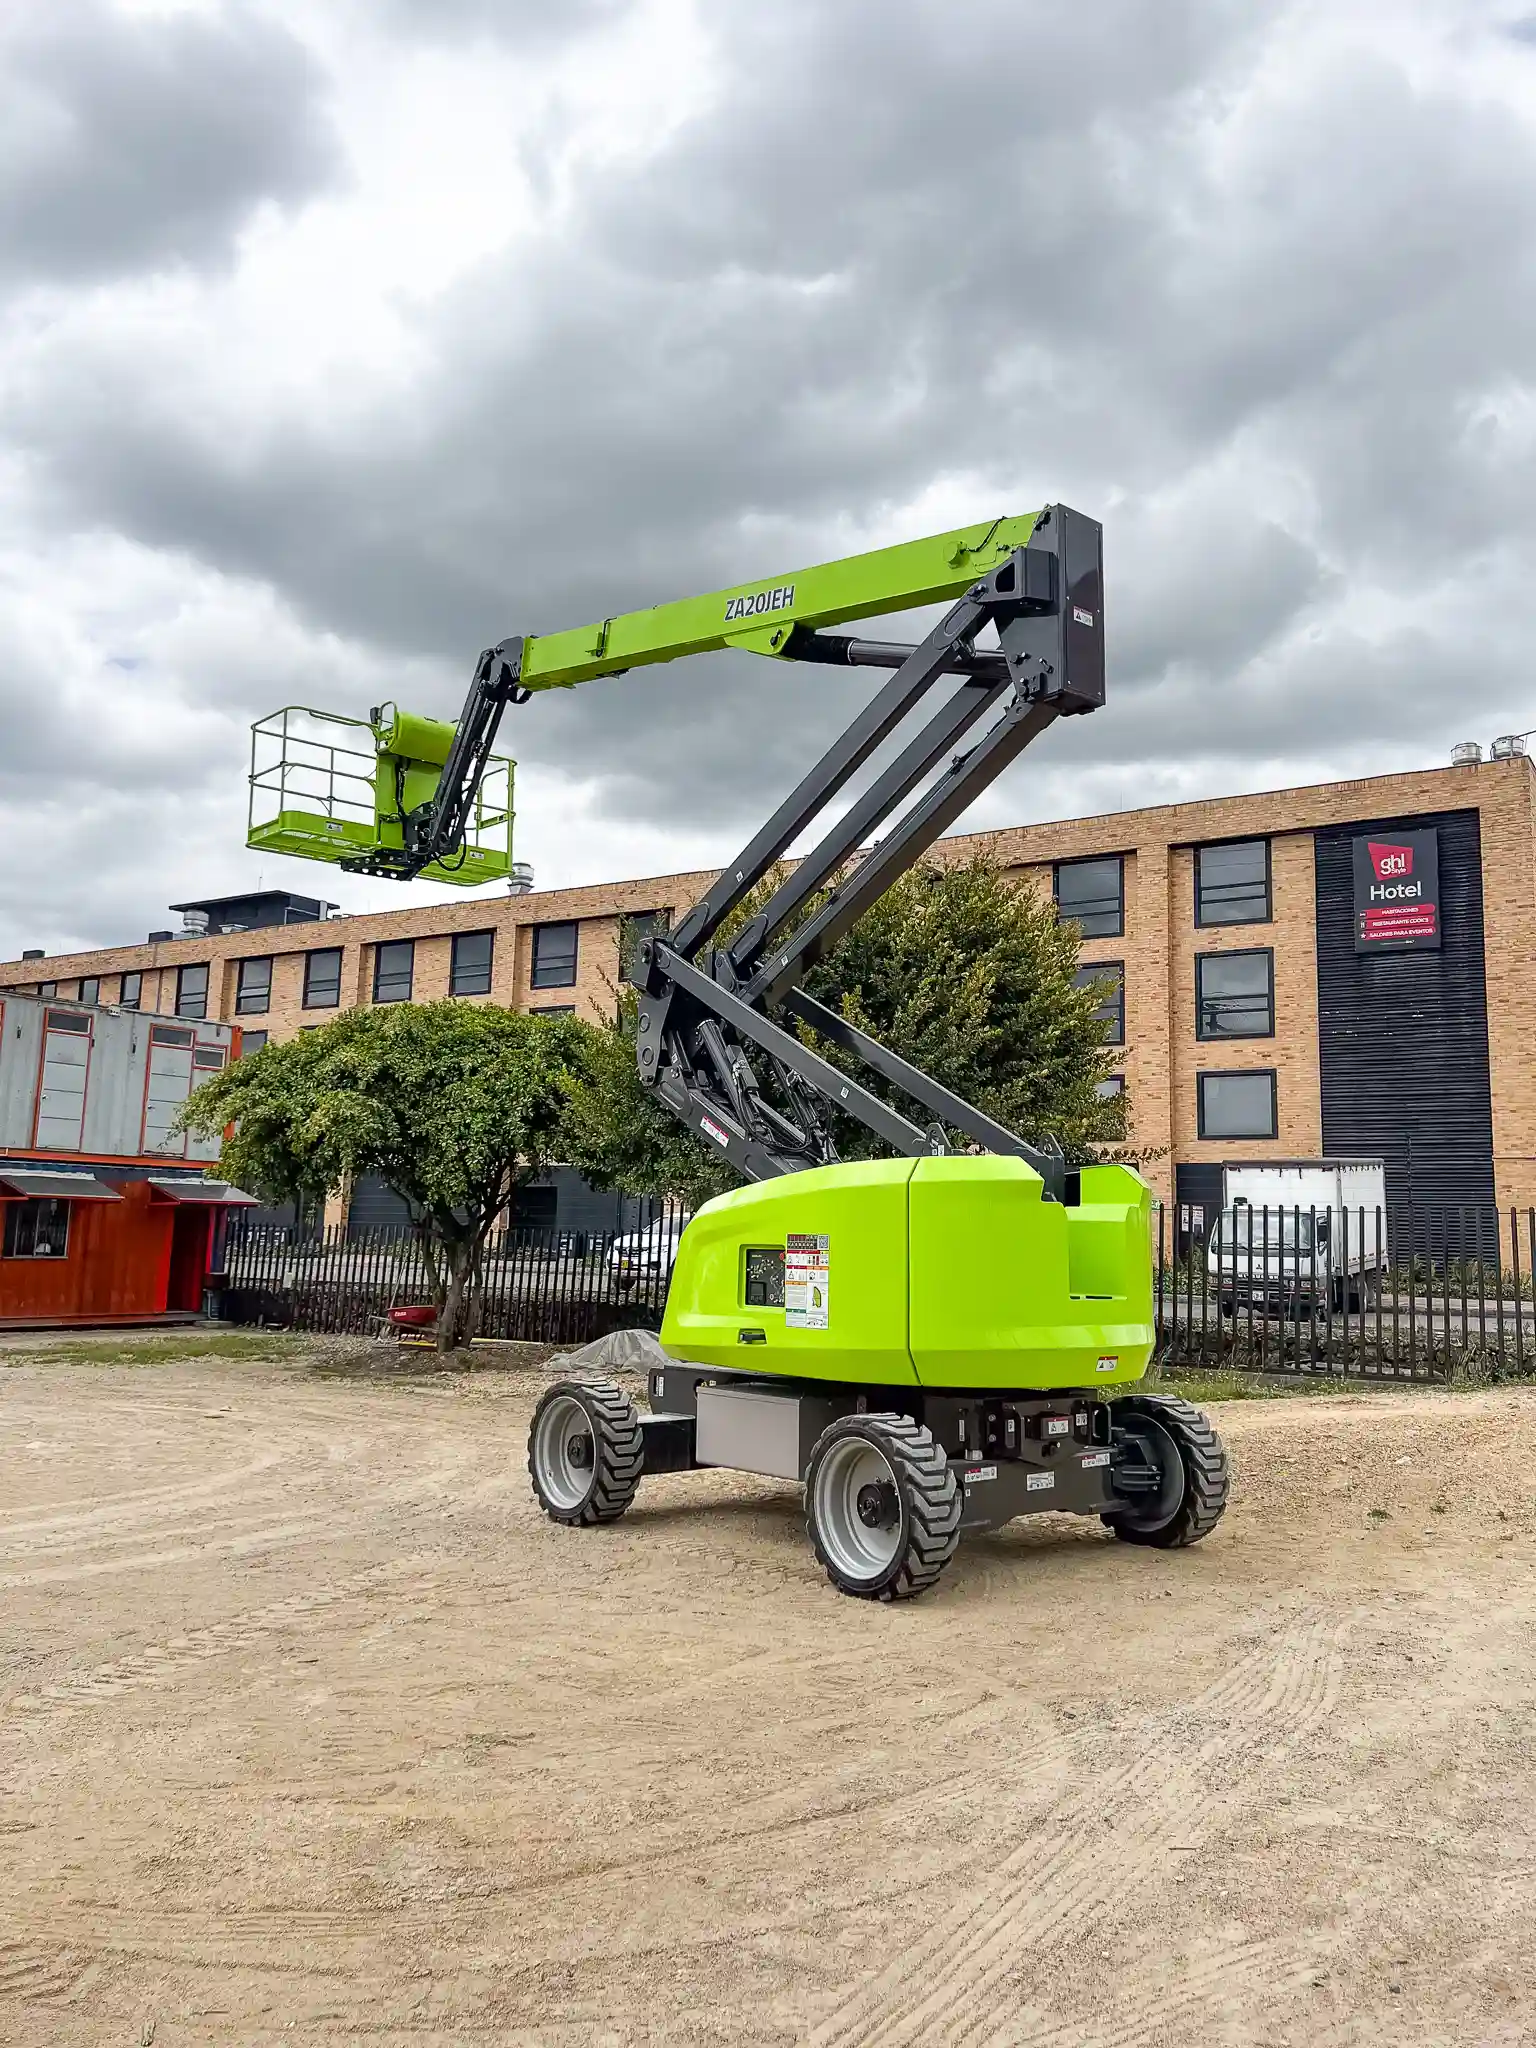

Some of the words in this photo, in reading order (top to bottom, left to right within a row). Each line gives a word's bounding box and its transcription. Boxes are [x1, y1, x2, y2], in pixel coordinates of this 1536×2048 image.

[725, 585, 795, 620] ZA20JEH
[1380, 853, 1405, 875] ghl
[1370, 881, 1422, 901] Hotel
